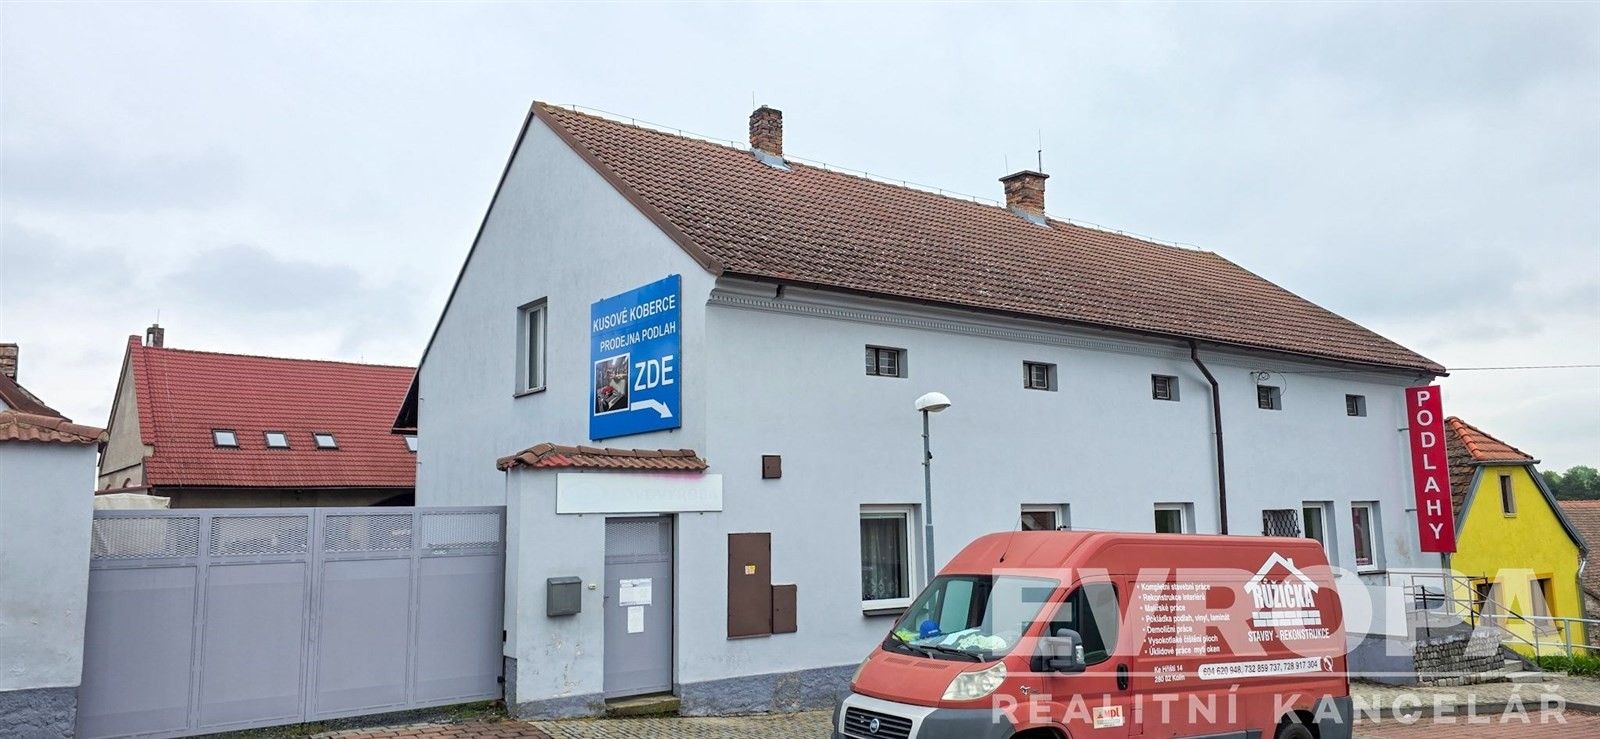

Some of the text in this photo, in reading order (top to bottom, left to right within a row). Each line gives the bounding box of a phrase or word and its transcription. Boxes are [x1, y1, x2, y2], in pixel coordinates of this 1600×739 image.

[593, 294, 676, 332] KUSOVÉ KOBERCE
[600, 321, 676, 352] PRODEJNA PODLAH
[634, 355, 674, 391] ZDE
[1416, 391, 1444, 540] PODLAHY
[1141, 583, 1210, 592] Kompletní stavební práce
[1252, 578, 1316, 608] RŮŽIČKA
[1142, 593, 1182, 601] Rekonstrukce
[1169, 604, 1185, 613] práce
[1147, 625, 1192, 634] Demoliční práce
[1248, 630, 1274, 642] STAVBY
[1279, 628, 1330, 641] REKONSTRUKCE
[1203, 634, 1219, 644] ploch
[1149, 646, 1175, 656] Úklidové
[1207, 645, 1220, 653] oken
[1216, 666, 1228, 675] 620
[1244, 664, 1256, 673] 732
[1257, 663, 1269, 673] 859
[1283, 662, 1294, 671] 728
[1295, 661, 1306, 670] 917
[1307, 660, 1318, 669] 304
